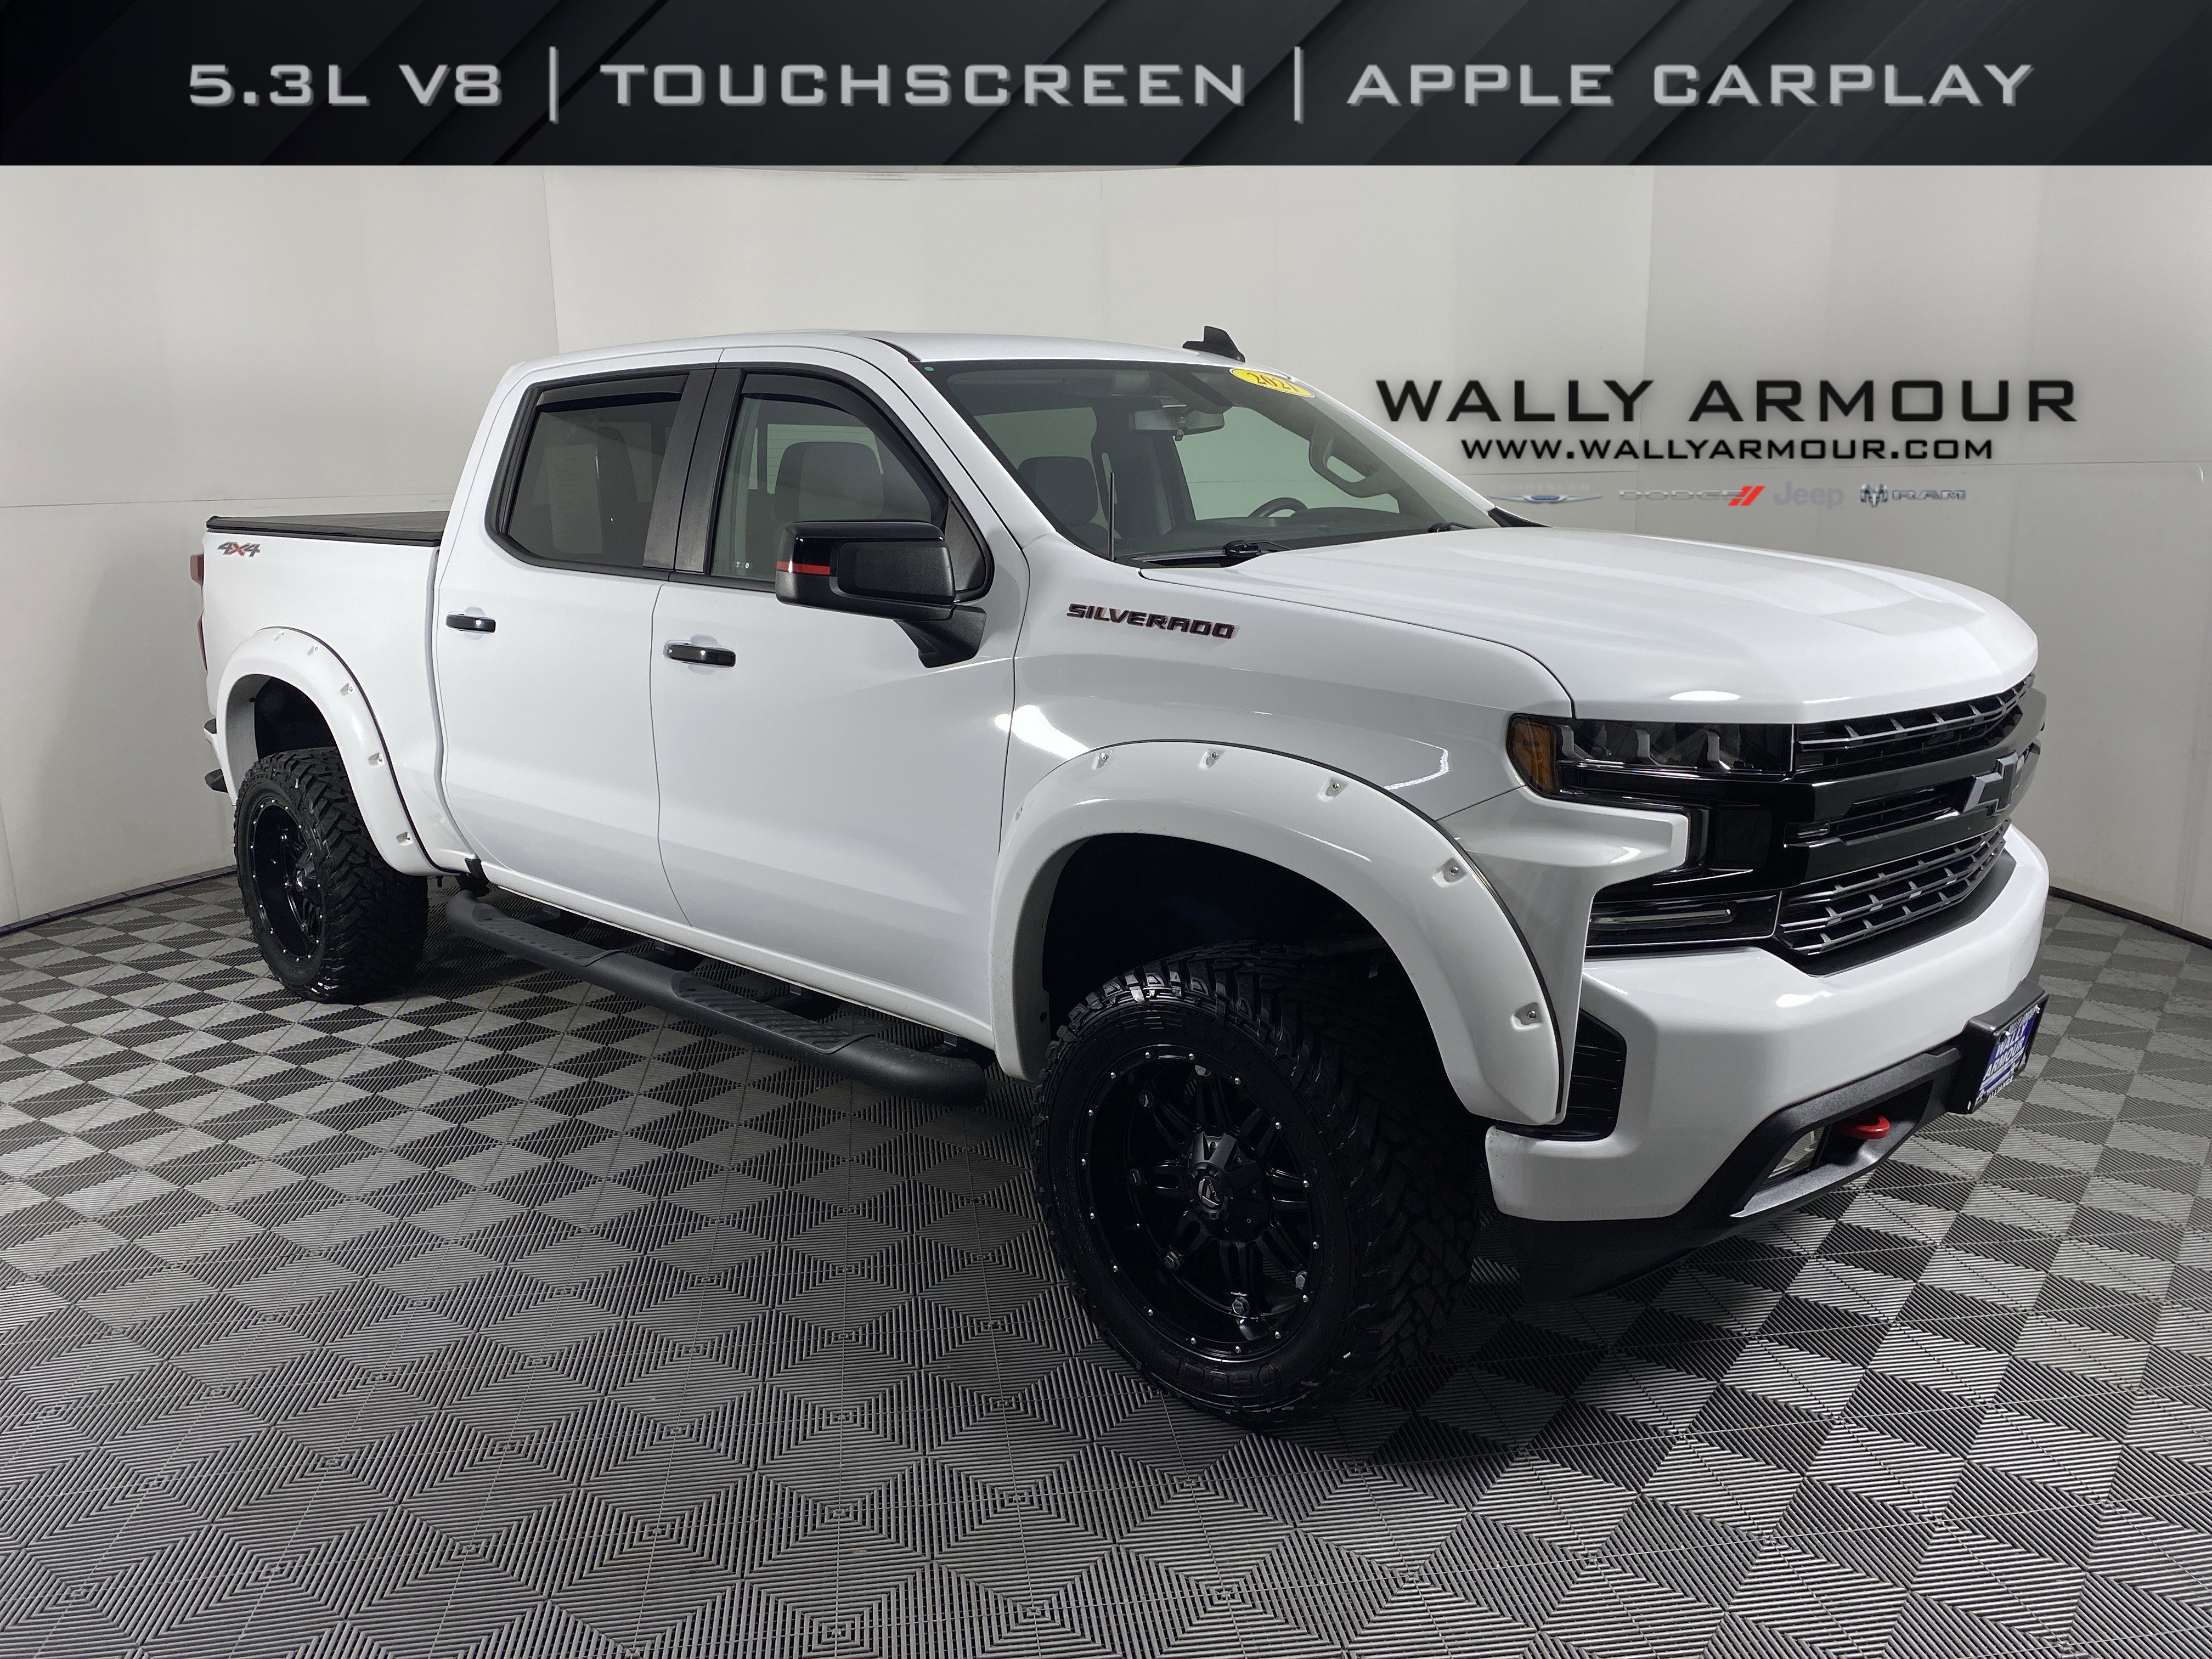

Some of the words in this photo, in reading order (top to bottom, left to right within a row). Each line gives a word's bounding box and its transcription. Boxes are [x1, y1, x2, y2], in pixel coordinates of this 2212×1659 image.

[1246, 372, 1300, 392] 2021
[1066, 603, 1237, 639] SILVERADO
[1995, 1019, 2029, 1058] WALLY
[1983, 1036, 2025, 1081] ARMOUR
